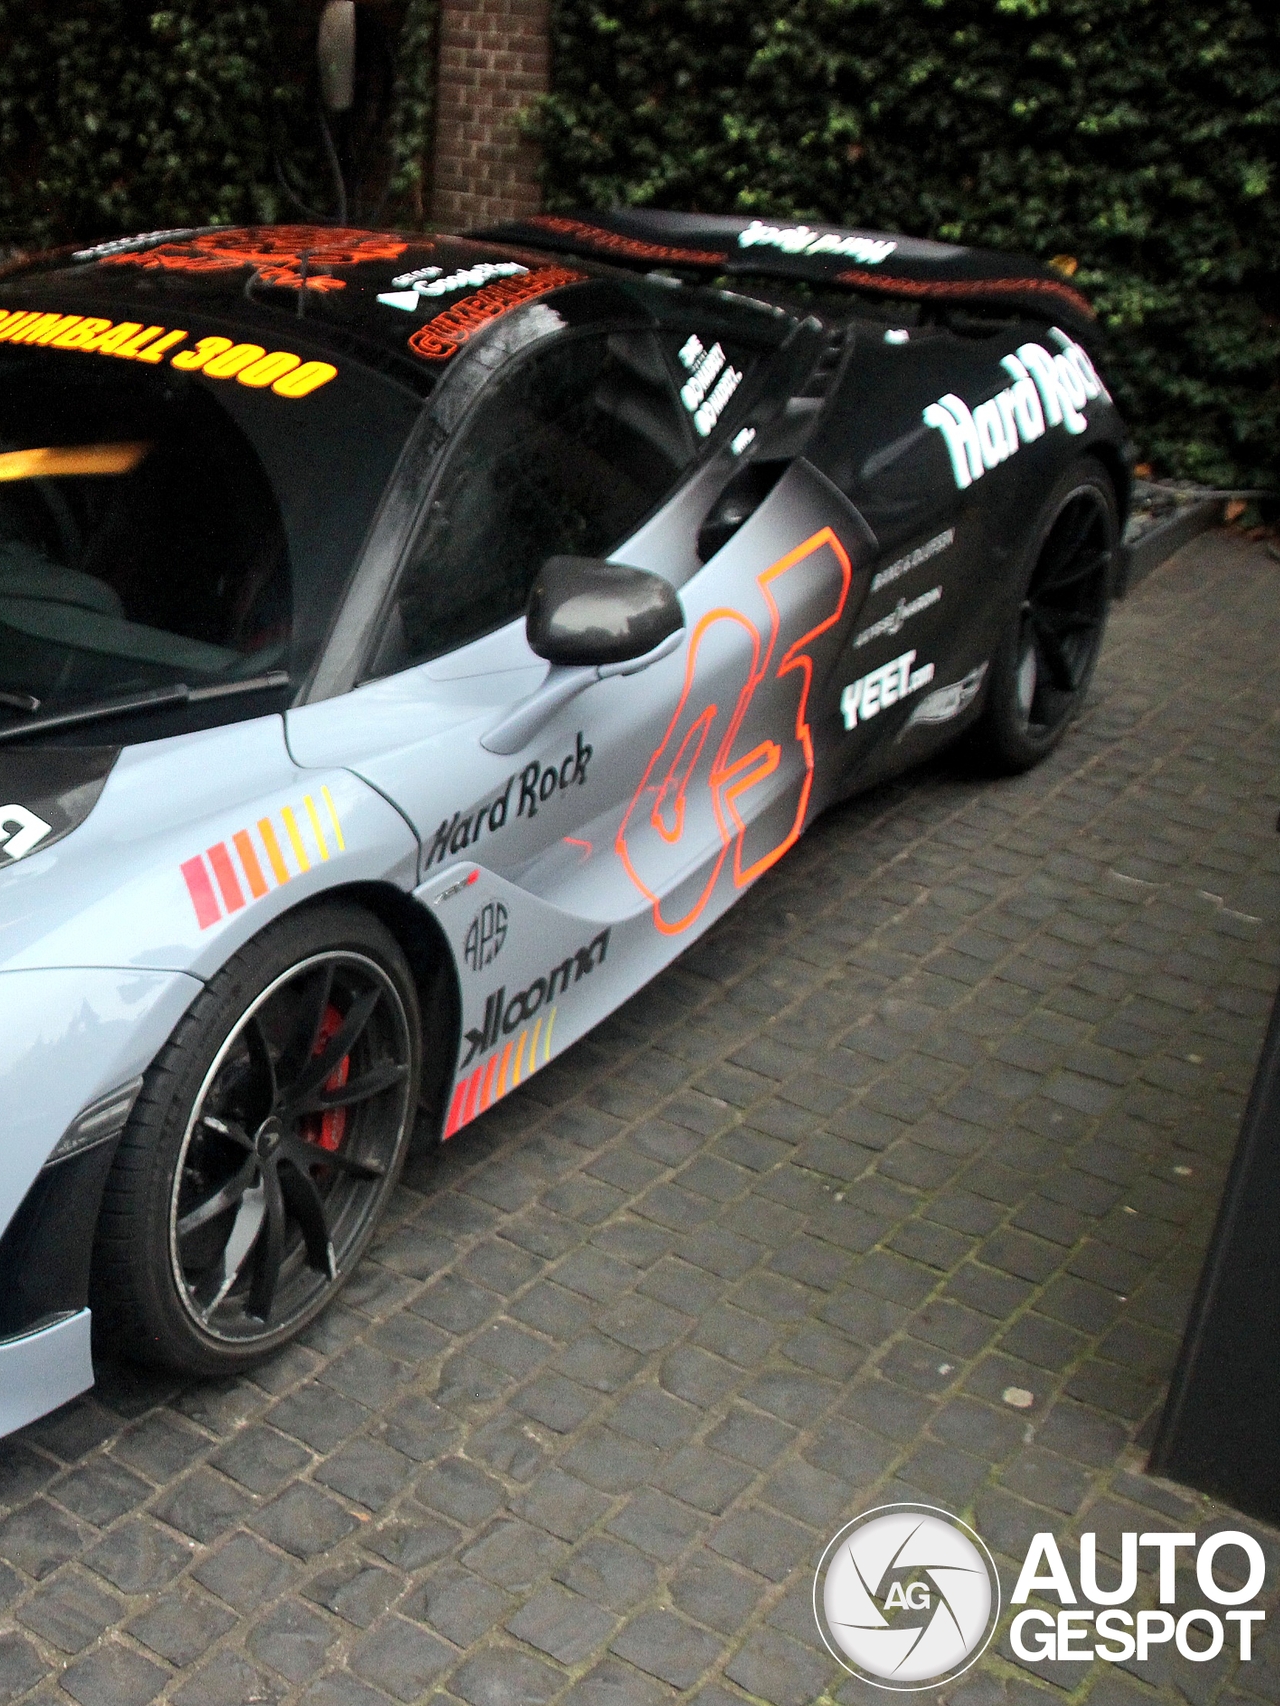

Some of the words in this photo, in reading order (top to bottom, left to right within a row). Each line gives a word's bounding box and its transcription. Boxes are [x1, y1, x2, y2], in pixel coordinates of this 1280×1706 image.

[171, 336, 338, 398] 3000
[922, 354, 1046, 489] Hard
[424, 772, 516, 871] Hard
[517, 730, 593, 819] Rock
